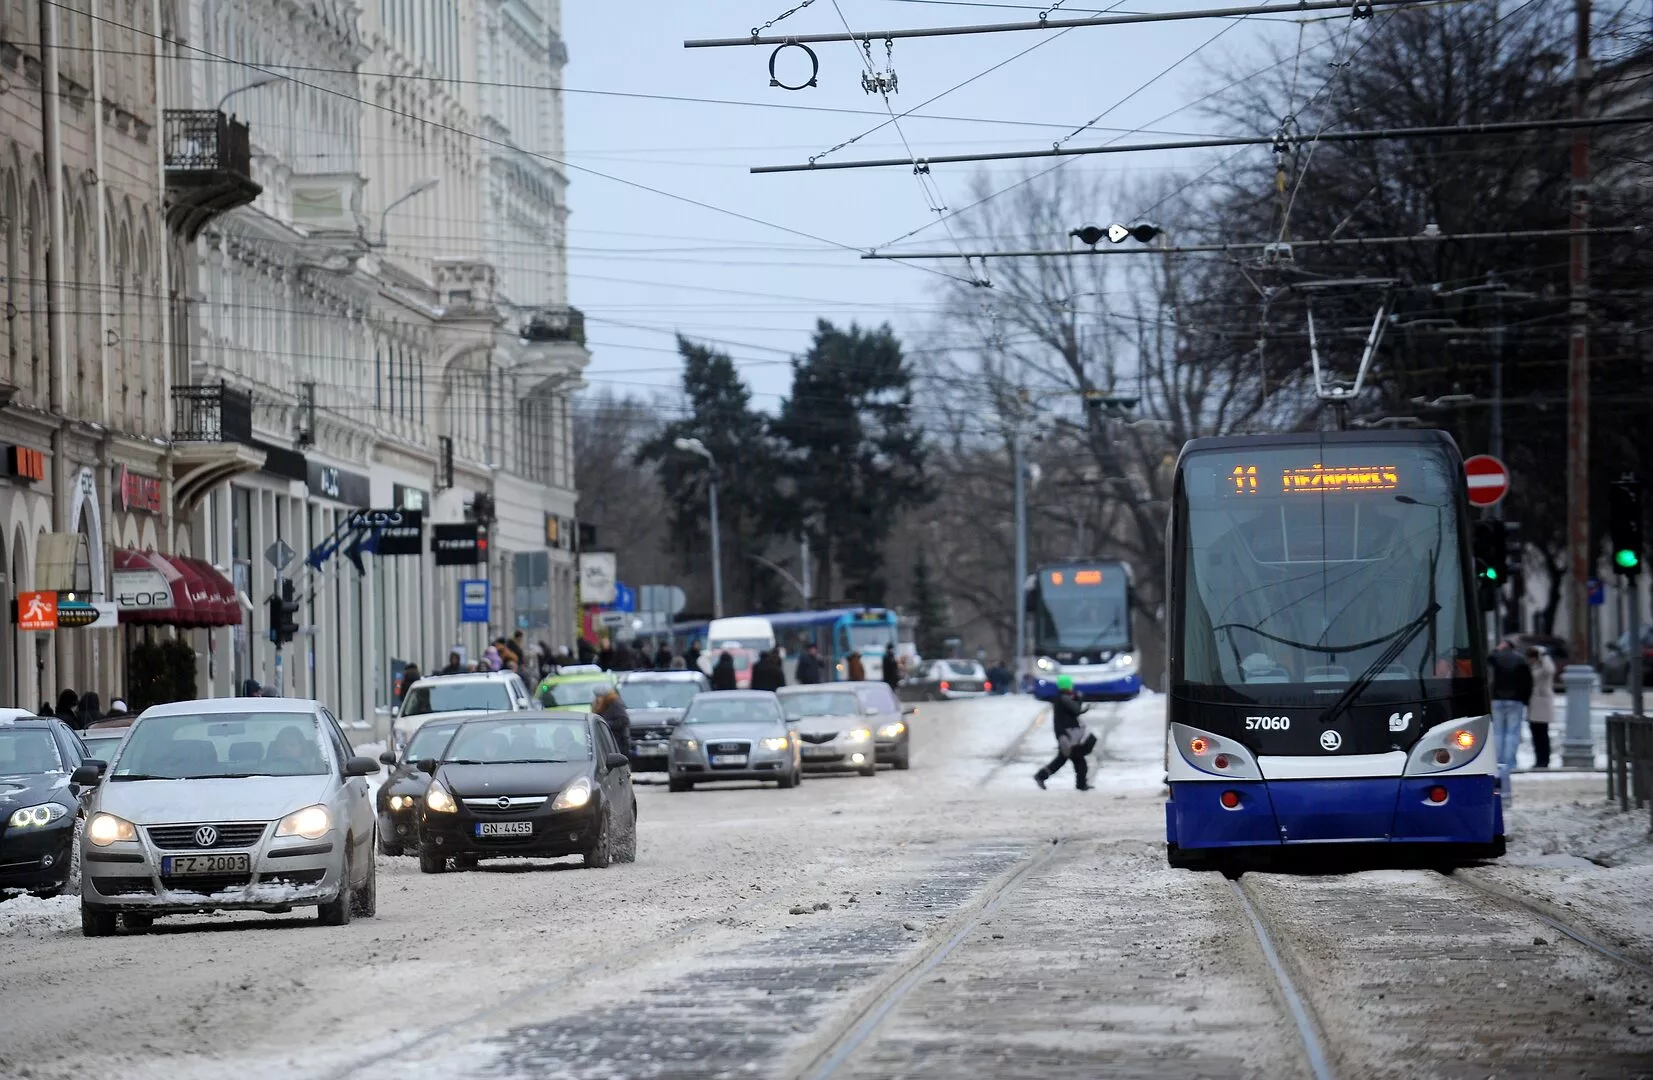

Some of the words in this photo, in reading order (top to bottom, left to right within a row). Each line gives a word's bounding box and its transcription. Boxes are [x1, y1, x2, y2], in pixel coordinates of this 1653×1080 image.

[1229, 465, 1257, 493] 11
[379, 527, 420, 538] TIGER
[438, 538, 476, 549] TIGER
[1245, 716, 1291, 731] 57060
[482, 822, 531, 834] GN-4455
[174, 856, 247, 873] FZ-2003
